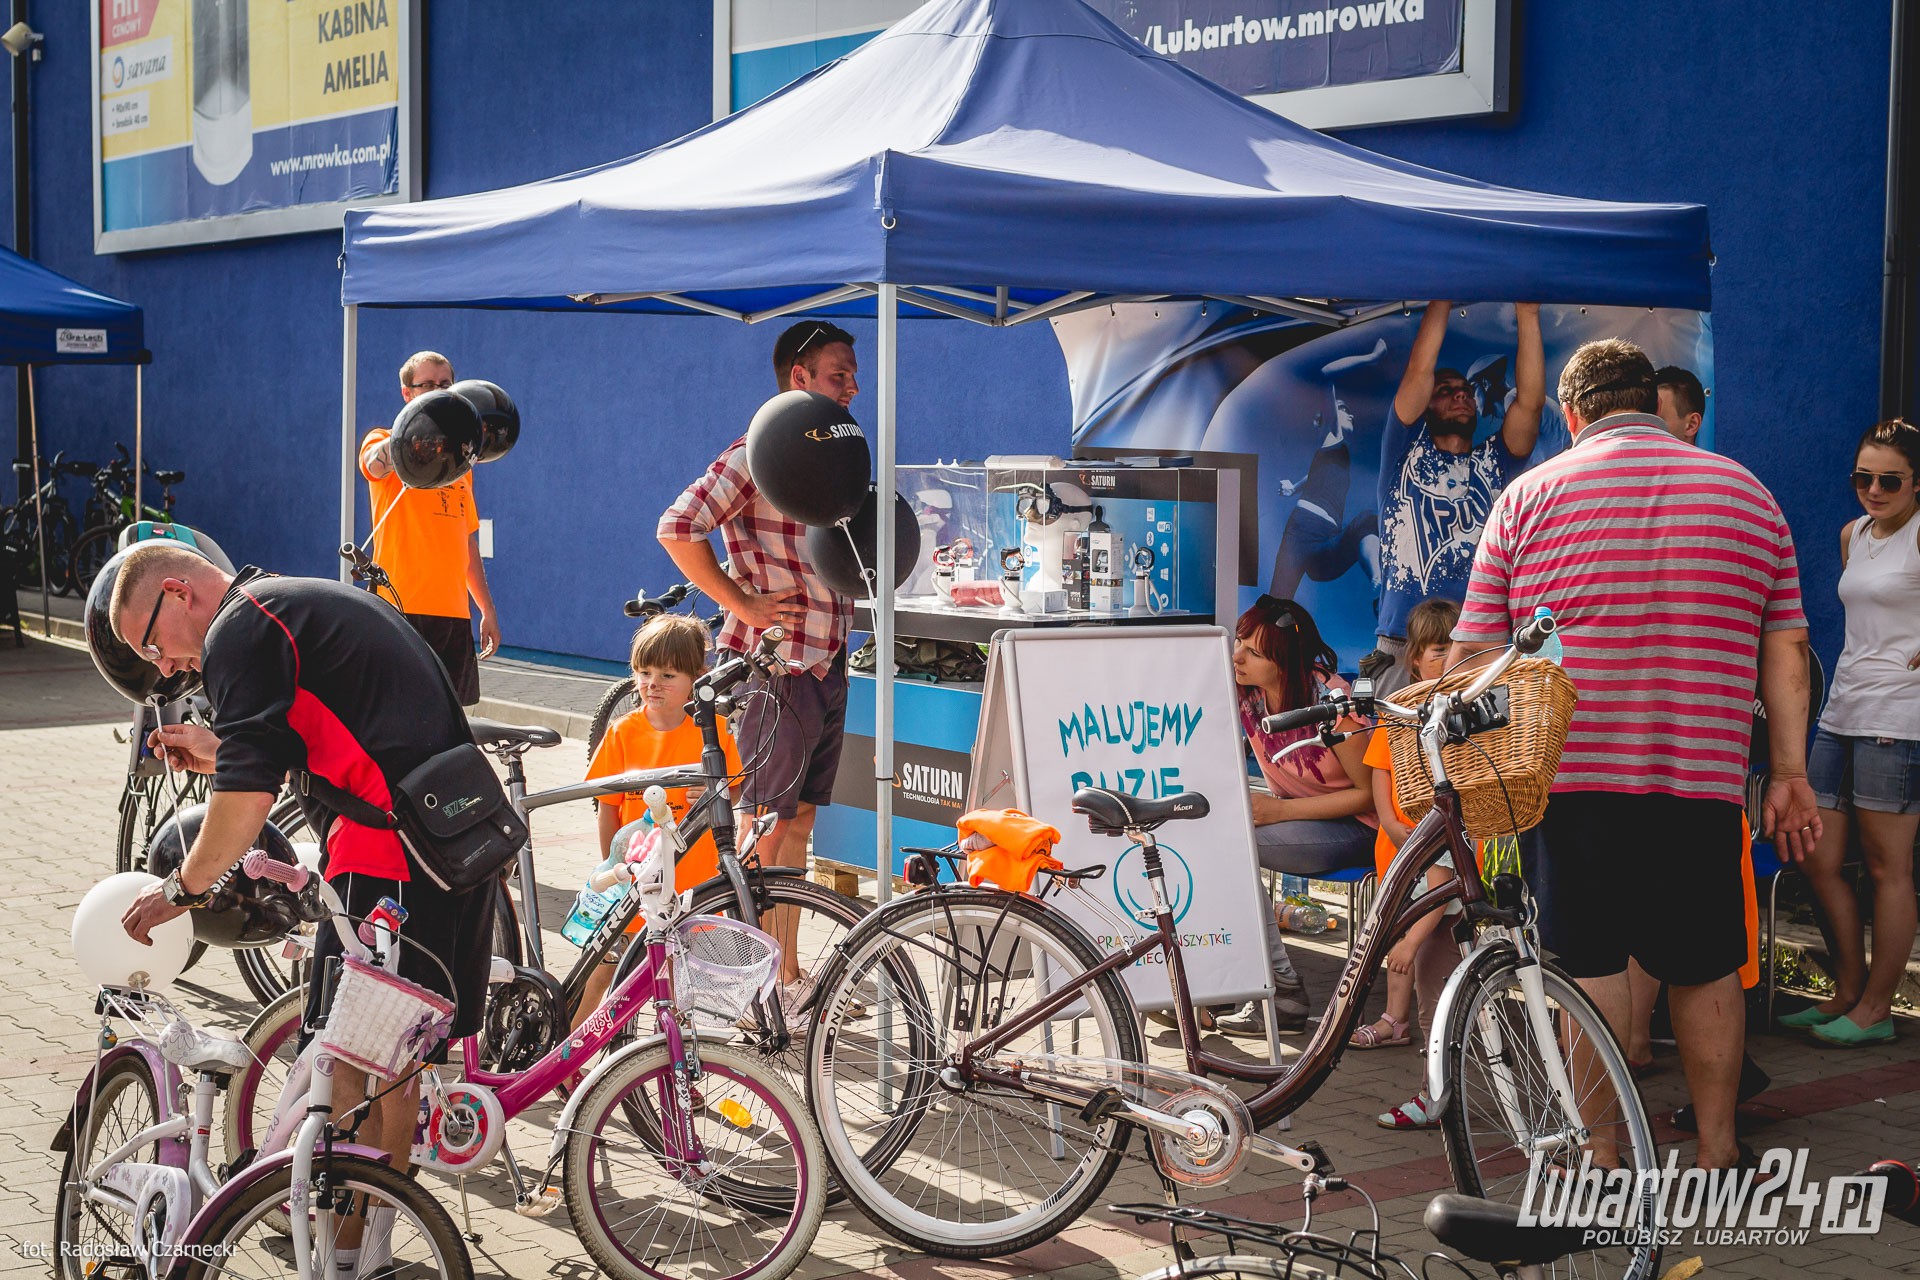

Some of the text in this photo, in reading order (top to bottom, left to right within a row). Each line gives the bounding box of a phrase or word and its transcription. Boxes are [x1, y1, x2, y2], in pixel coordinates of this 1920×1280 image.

[318, 0, 389, 44] KABINA
[126, 53, 166, 81] savana
[323, 50, 389, 95] AMELIA
[270, 133, 391, 177] www.mrowka.com.pl
[1091, 475, 1116, 487] SATURN
[1058, 700, 1203, 758] MALUJEMY
[902, 762, 963, 800] SATURN
[902, 791, 940, 806] TECHNOLOGIA
[582, 1009, 614, 1036] Daisy
